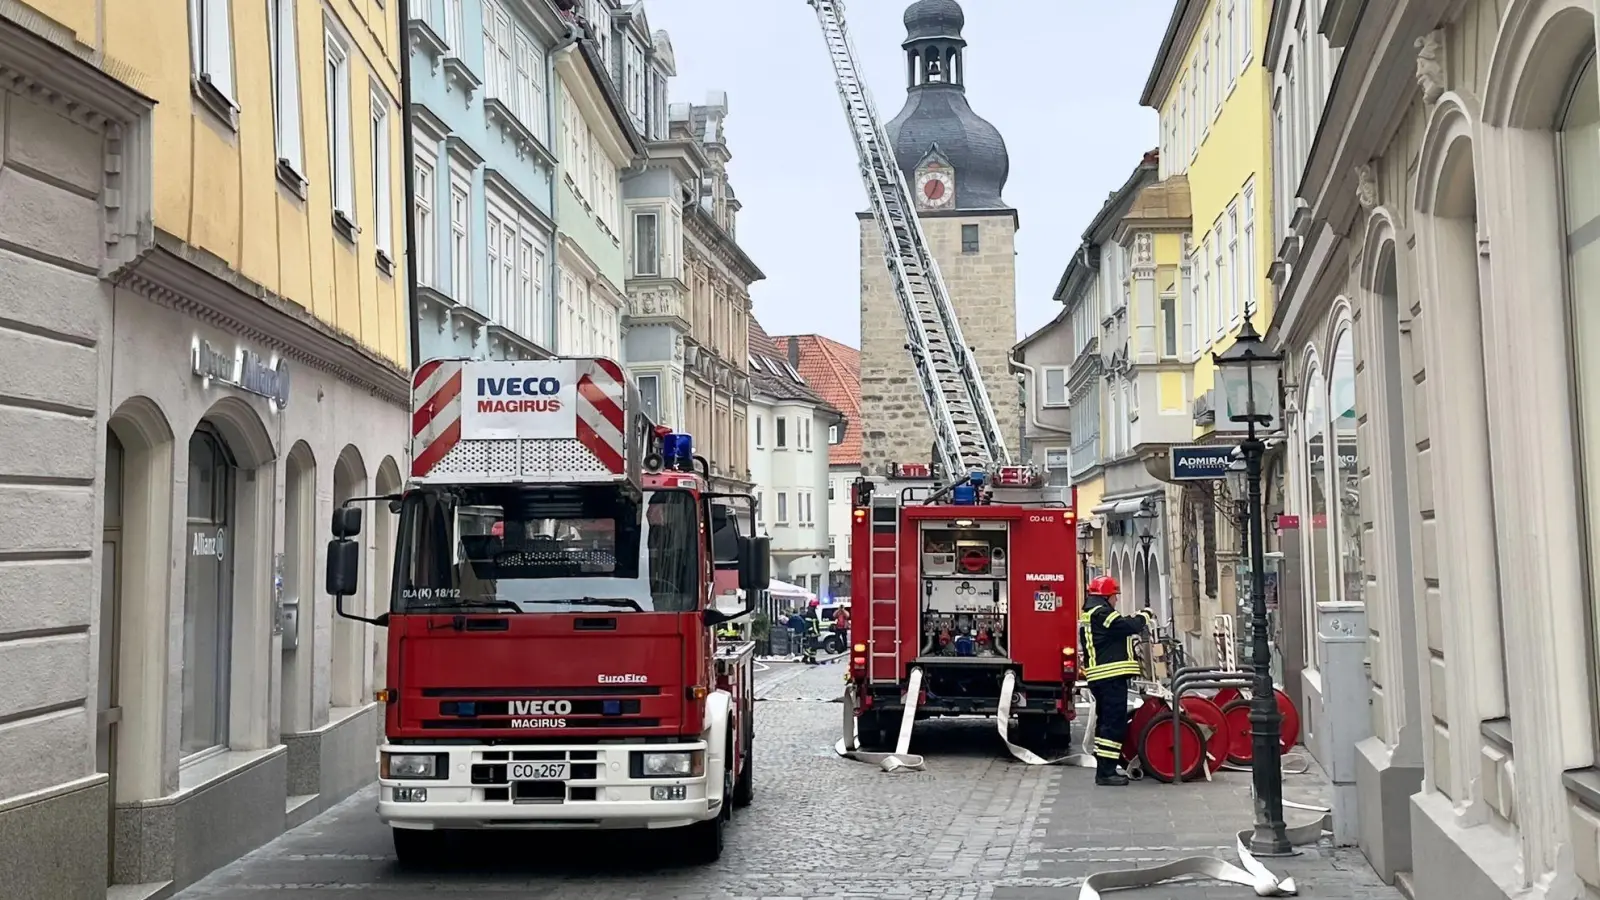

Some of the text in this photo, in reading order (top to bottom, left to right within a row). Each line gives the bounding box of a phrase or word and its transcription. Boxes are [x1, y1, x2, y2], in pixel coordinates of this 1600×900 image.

[477, 377, 561, 396] IVECO
[477, 399, 561, 413] MAGIRUS
[1178, 456, 1233, 466] ADMIRAL
[193, 532, 216, 556] Allianz
[1025, 573, 1065, 581] MAGIRUS
[435, 588, 461, 598] 18/12
[1038, 593, 1050, 601] CO
[1037, 602, 1053, 610] 242
[508, 700, 572, 715] IVECO
[511, 718, 567, 728] MAGIRUS
[513, 764, 565, 778] CO 267
